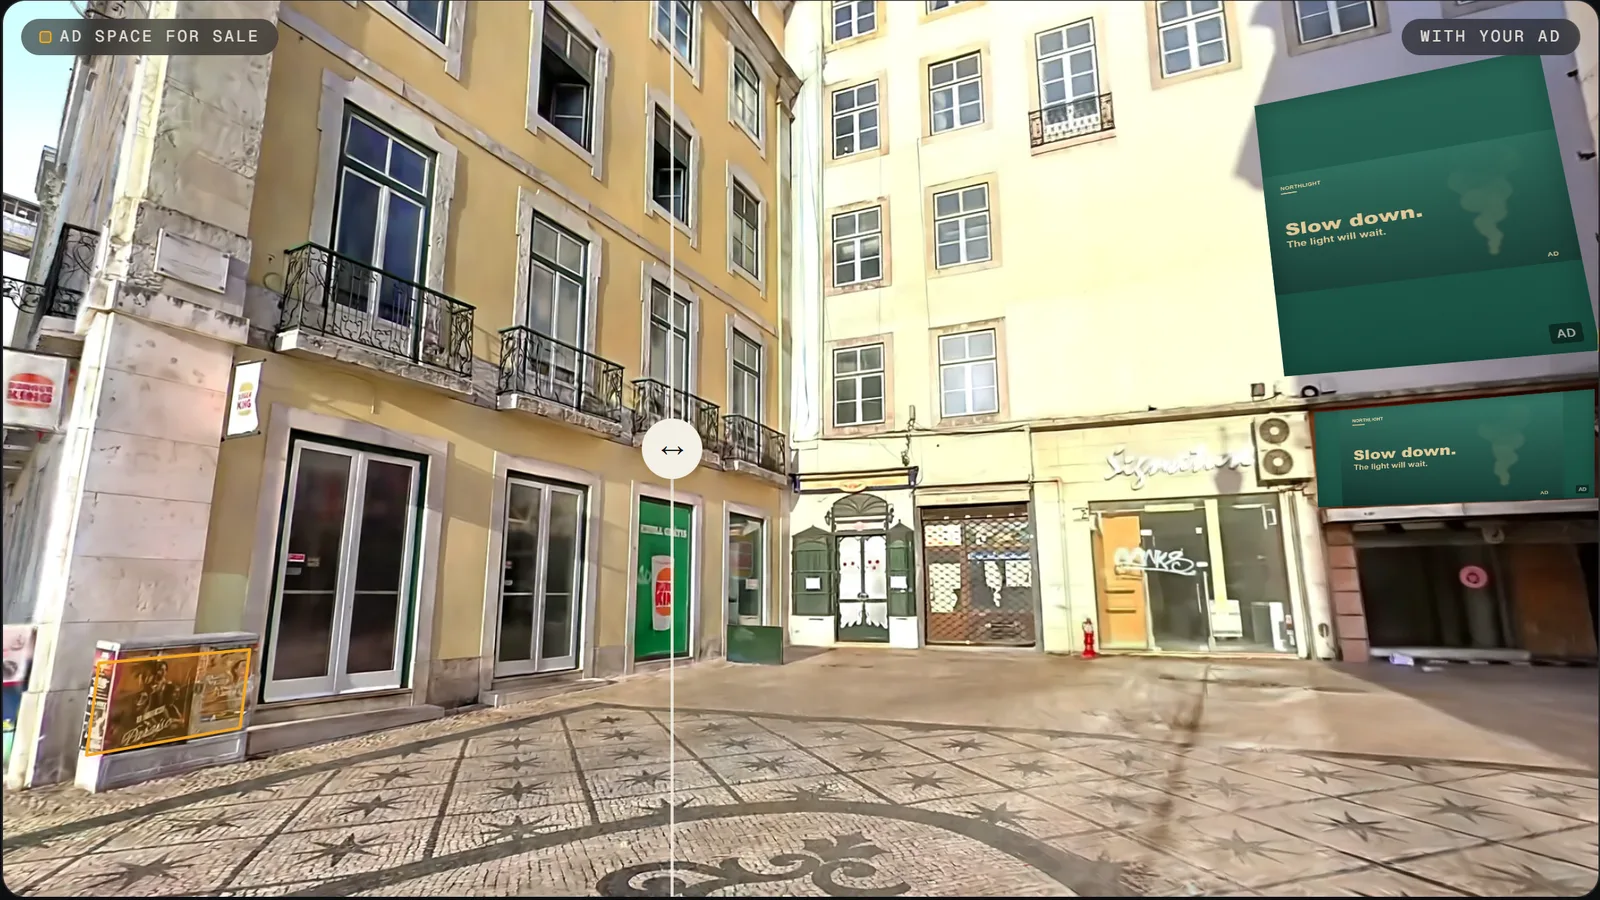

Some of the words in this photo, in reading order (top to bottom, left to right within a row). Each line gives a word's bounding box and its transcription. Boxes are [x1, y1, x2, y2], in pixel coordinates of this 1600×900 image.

[1279, 180, 1321, 191] NORTHLIGHT
[1285, 218, 1342, 236] Slow
[1349, 208, 1423, 227] down.
[1286, 240, 1307, 248] The
[1309, 234, 1335, 246] light
[1336, 232, 1357, 242] will
[1359, 228, 1387, 239] wait.
[7, 390, 53, 403] KING
[236, 398, 252, 410] KING
[1353, 449, 1396, 461] Slow
[1401, 446, 1456, 458] down.
[1353, 463, 1369, 471] The
[1371, 462, 1389, 472] light
[1391, 461, 1406, 469] will
[1407, 460, 1429, 468] wait.
